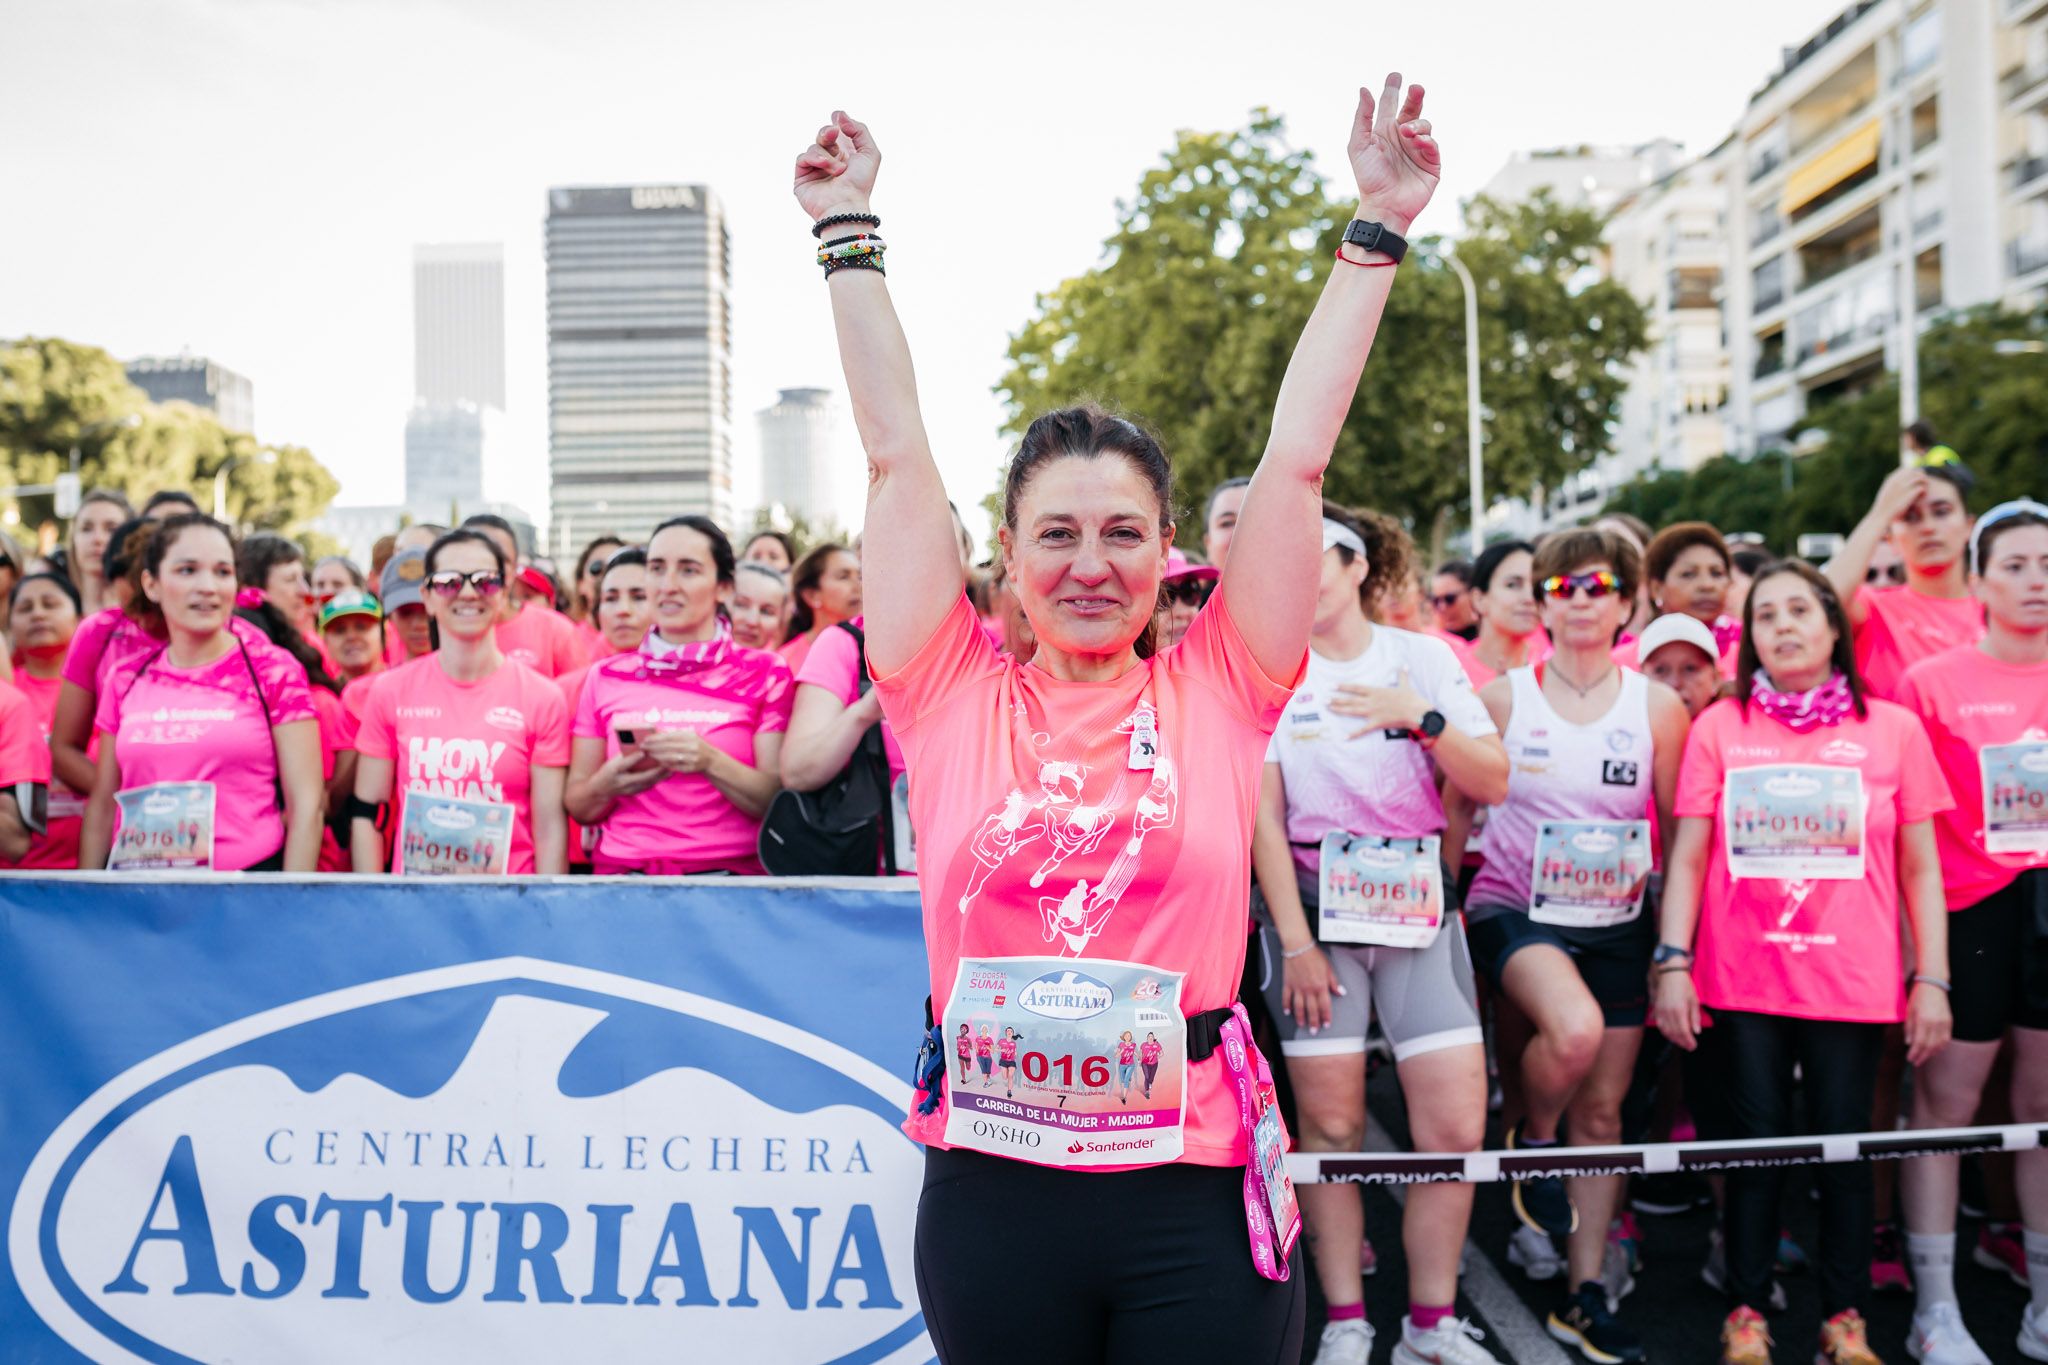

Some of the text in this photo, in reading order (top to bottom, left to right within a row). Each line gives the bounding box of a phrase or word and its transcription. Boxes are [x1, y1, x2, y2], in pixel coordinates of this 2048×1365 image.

[1770, 816, 1821, 832] 016
[135, 831, 173, 848] 016
[426, 843, 469, 863] 016
[1574, 869, 1616, 886] 016
[1361, 882, 1406, 900] 016
[969, 978, 1006, 991] SUMA
[981, 971, 1008, 980] DORSAL
[1023, 988, 1107, 1009] ASTURIANA
[1021, 1051, 1110, 1088] 016
[1057, 1095, 1067, 1108] 7
[975, 1097, 1154, 1128] CARRERA DE LA MUJER MADRID
[973, 1119, 1041, 1148] OYSHO
[264, 1128, 874, 1175] CENTRAL LECHERA
[1086, 1138, 1155, 1153] Santander
[103, 1134, 904, 1311] ASTURIANA
